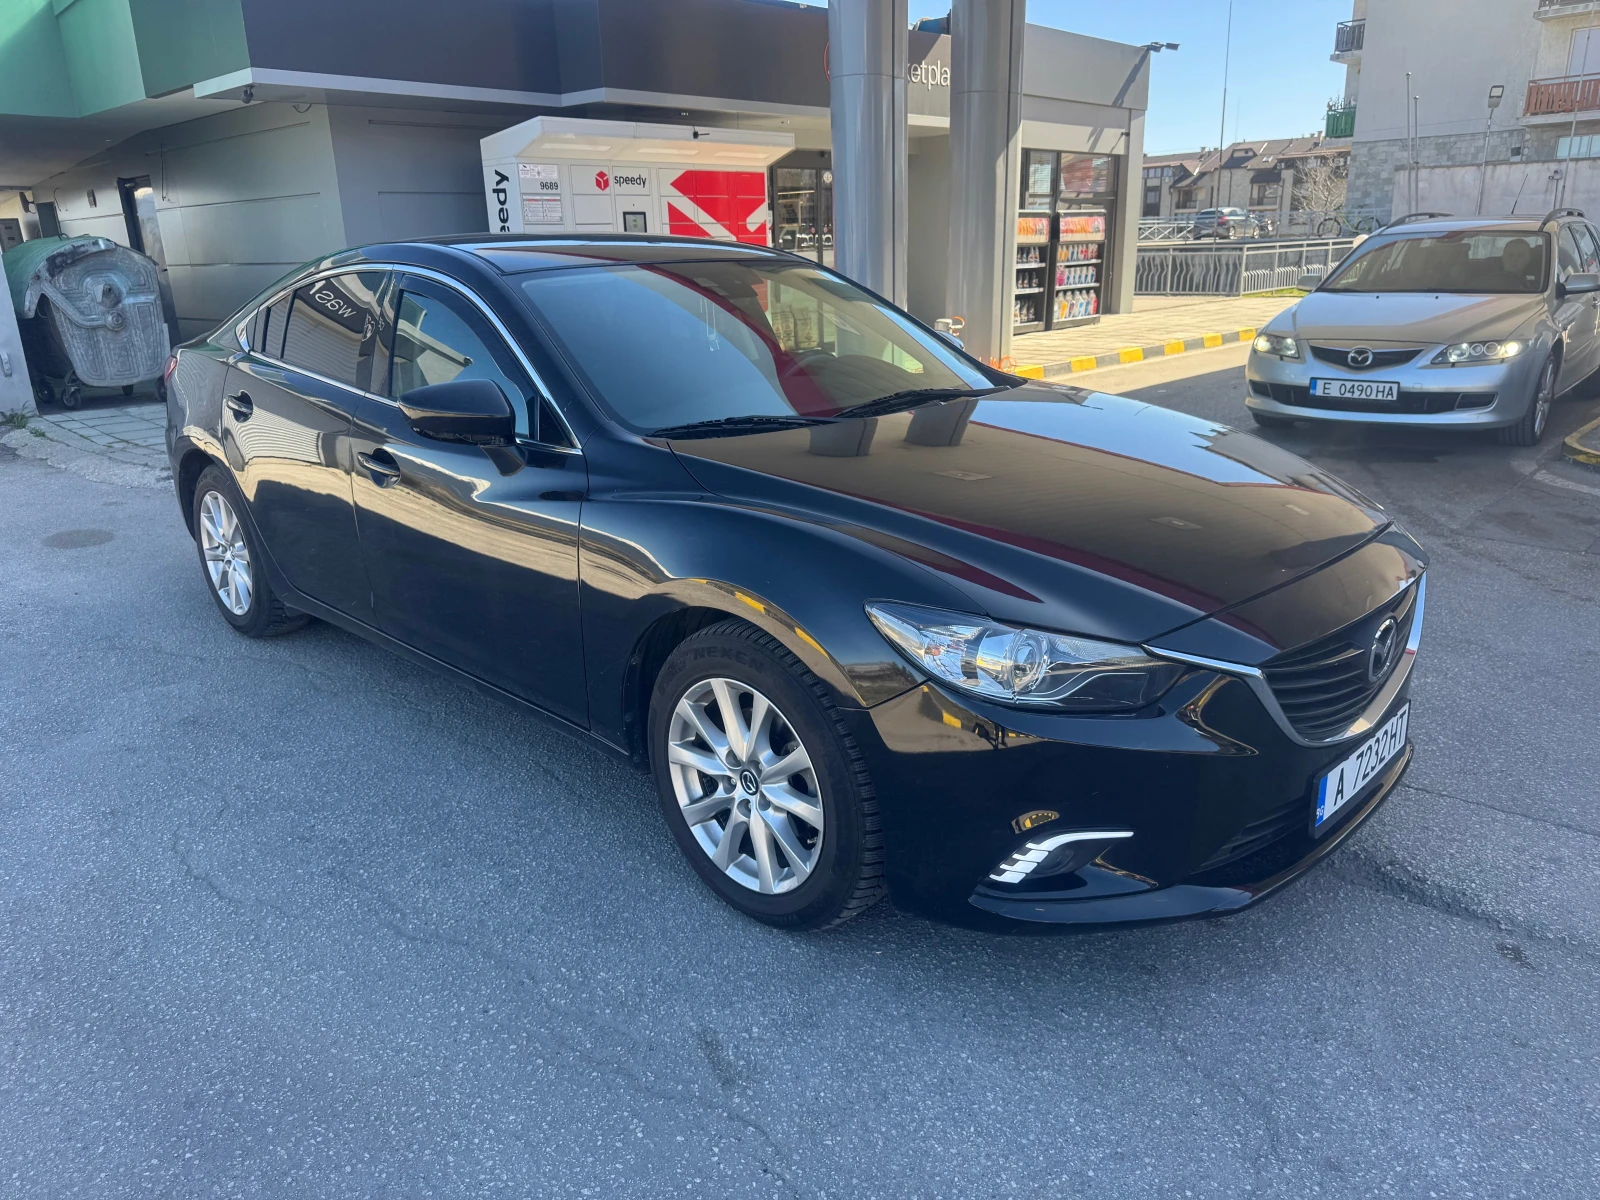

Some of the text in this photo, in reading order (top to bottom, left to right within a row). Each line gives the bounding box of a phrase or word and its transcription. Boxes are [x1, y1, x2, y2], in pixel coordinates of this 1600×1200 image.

[540, 181, 559, 190] 9689
[614, 174, 647, 188] speedy
[1322, 382, 1331, 395] E
[1339, 383, 1373, 398] 0490
[1375, 385, 1394, 399] HA
[693, 646, 765, 674] NEXEN
[1333, 767, 1345, 807] A
